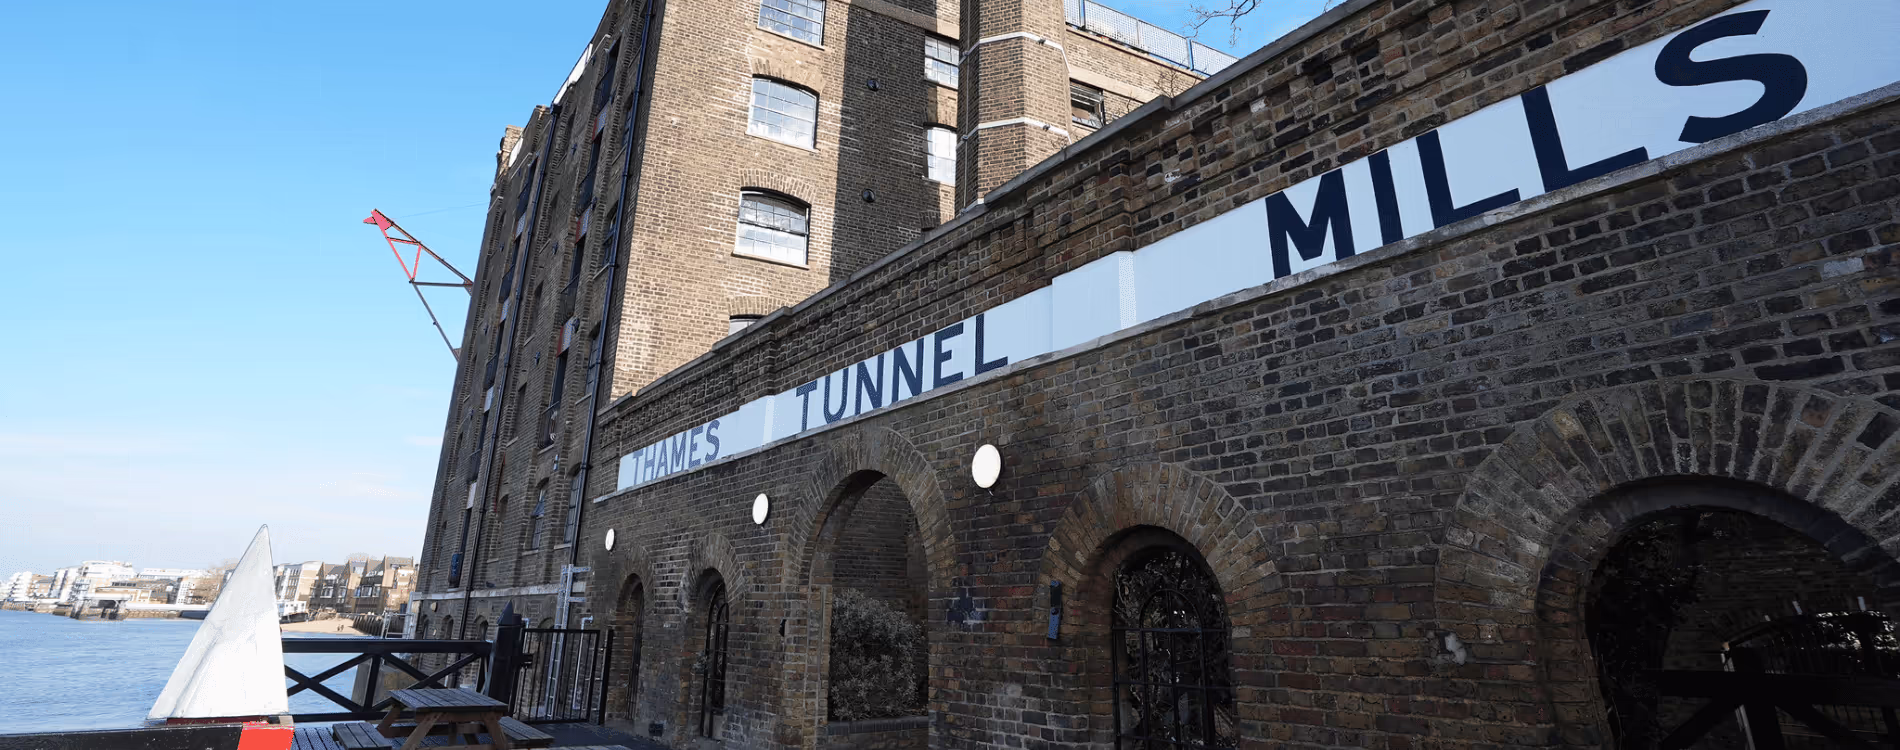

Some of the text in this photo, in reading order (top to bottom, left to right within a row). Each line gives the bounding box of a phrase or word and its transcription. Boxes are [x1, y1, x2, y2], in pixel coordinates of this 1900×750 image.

[632, 9, 1808, 486] THAMES TUNNEL MILLS
